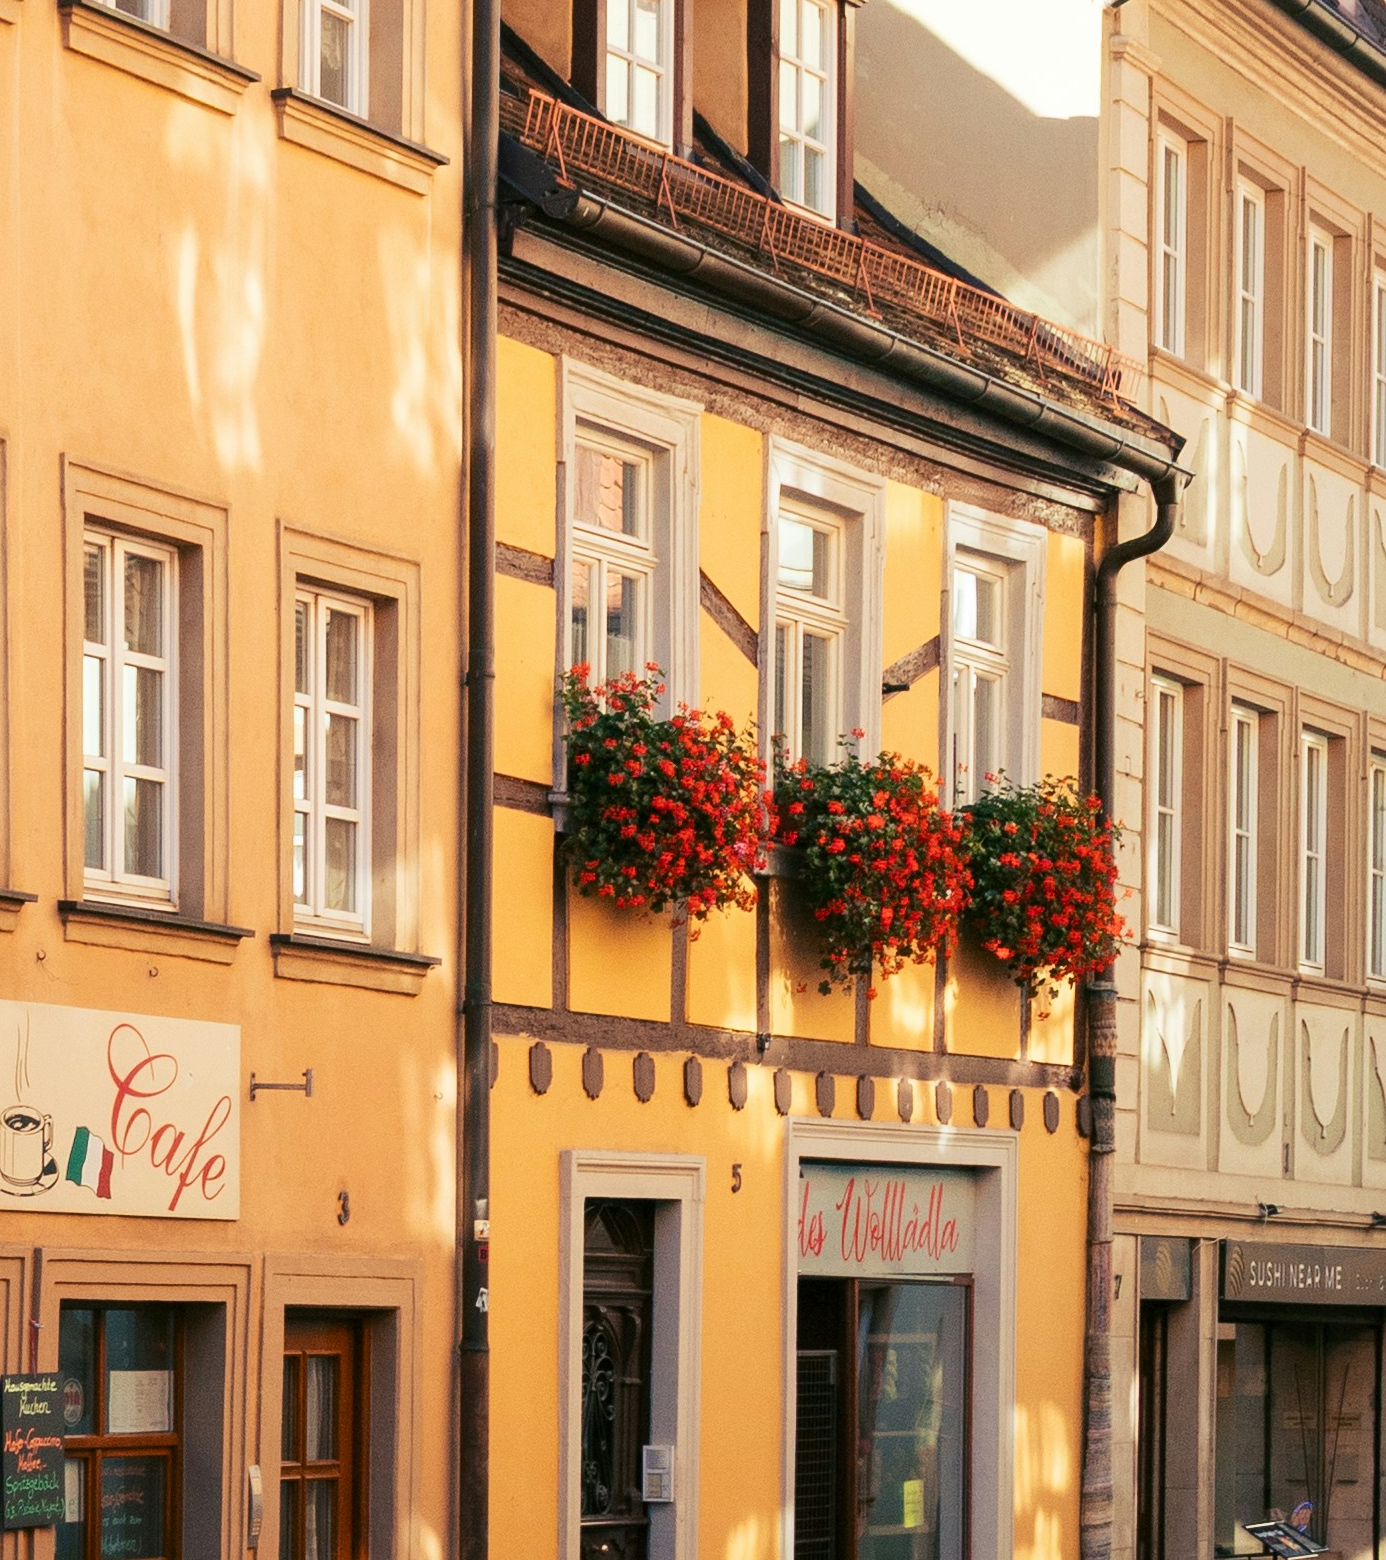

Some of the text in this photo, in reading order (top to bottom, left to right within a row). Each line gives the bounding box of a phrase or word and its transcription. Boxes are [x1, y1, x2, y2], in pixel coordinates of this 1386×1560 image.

[107, 1023, 233, 1212] Cafe
[731, 1163, 742, 1193] 5
[337, 1190, 351, 1226] 3
[1250, 1261, 1286, 1288] SUSHI
[1289, 1263, 1321, 1290] NEAR
[1325, 1266, 1342, 1290] ME
